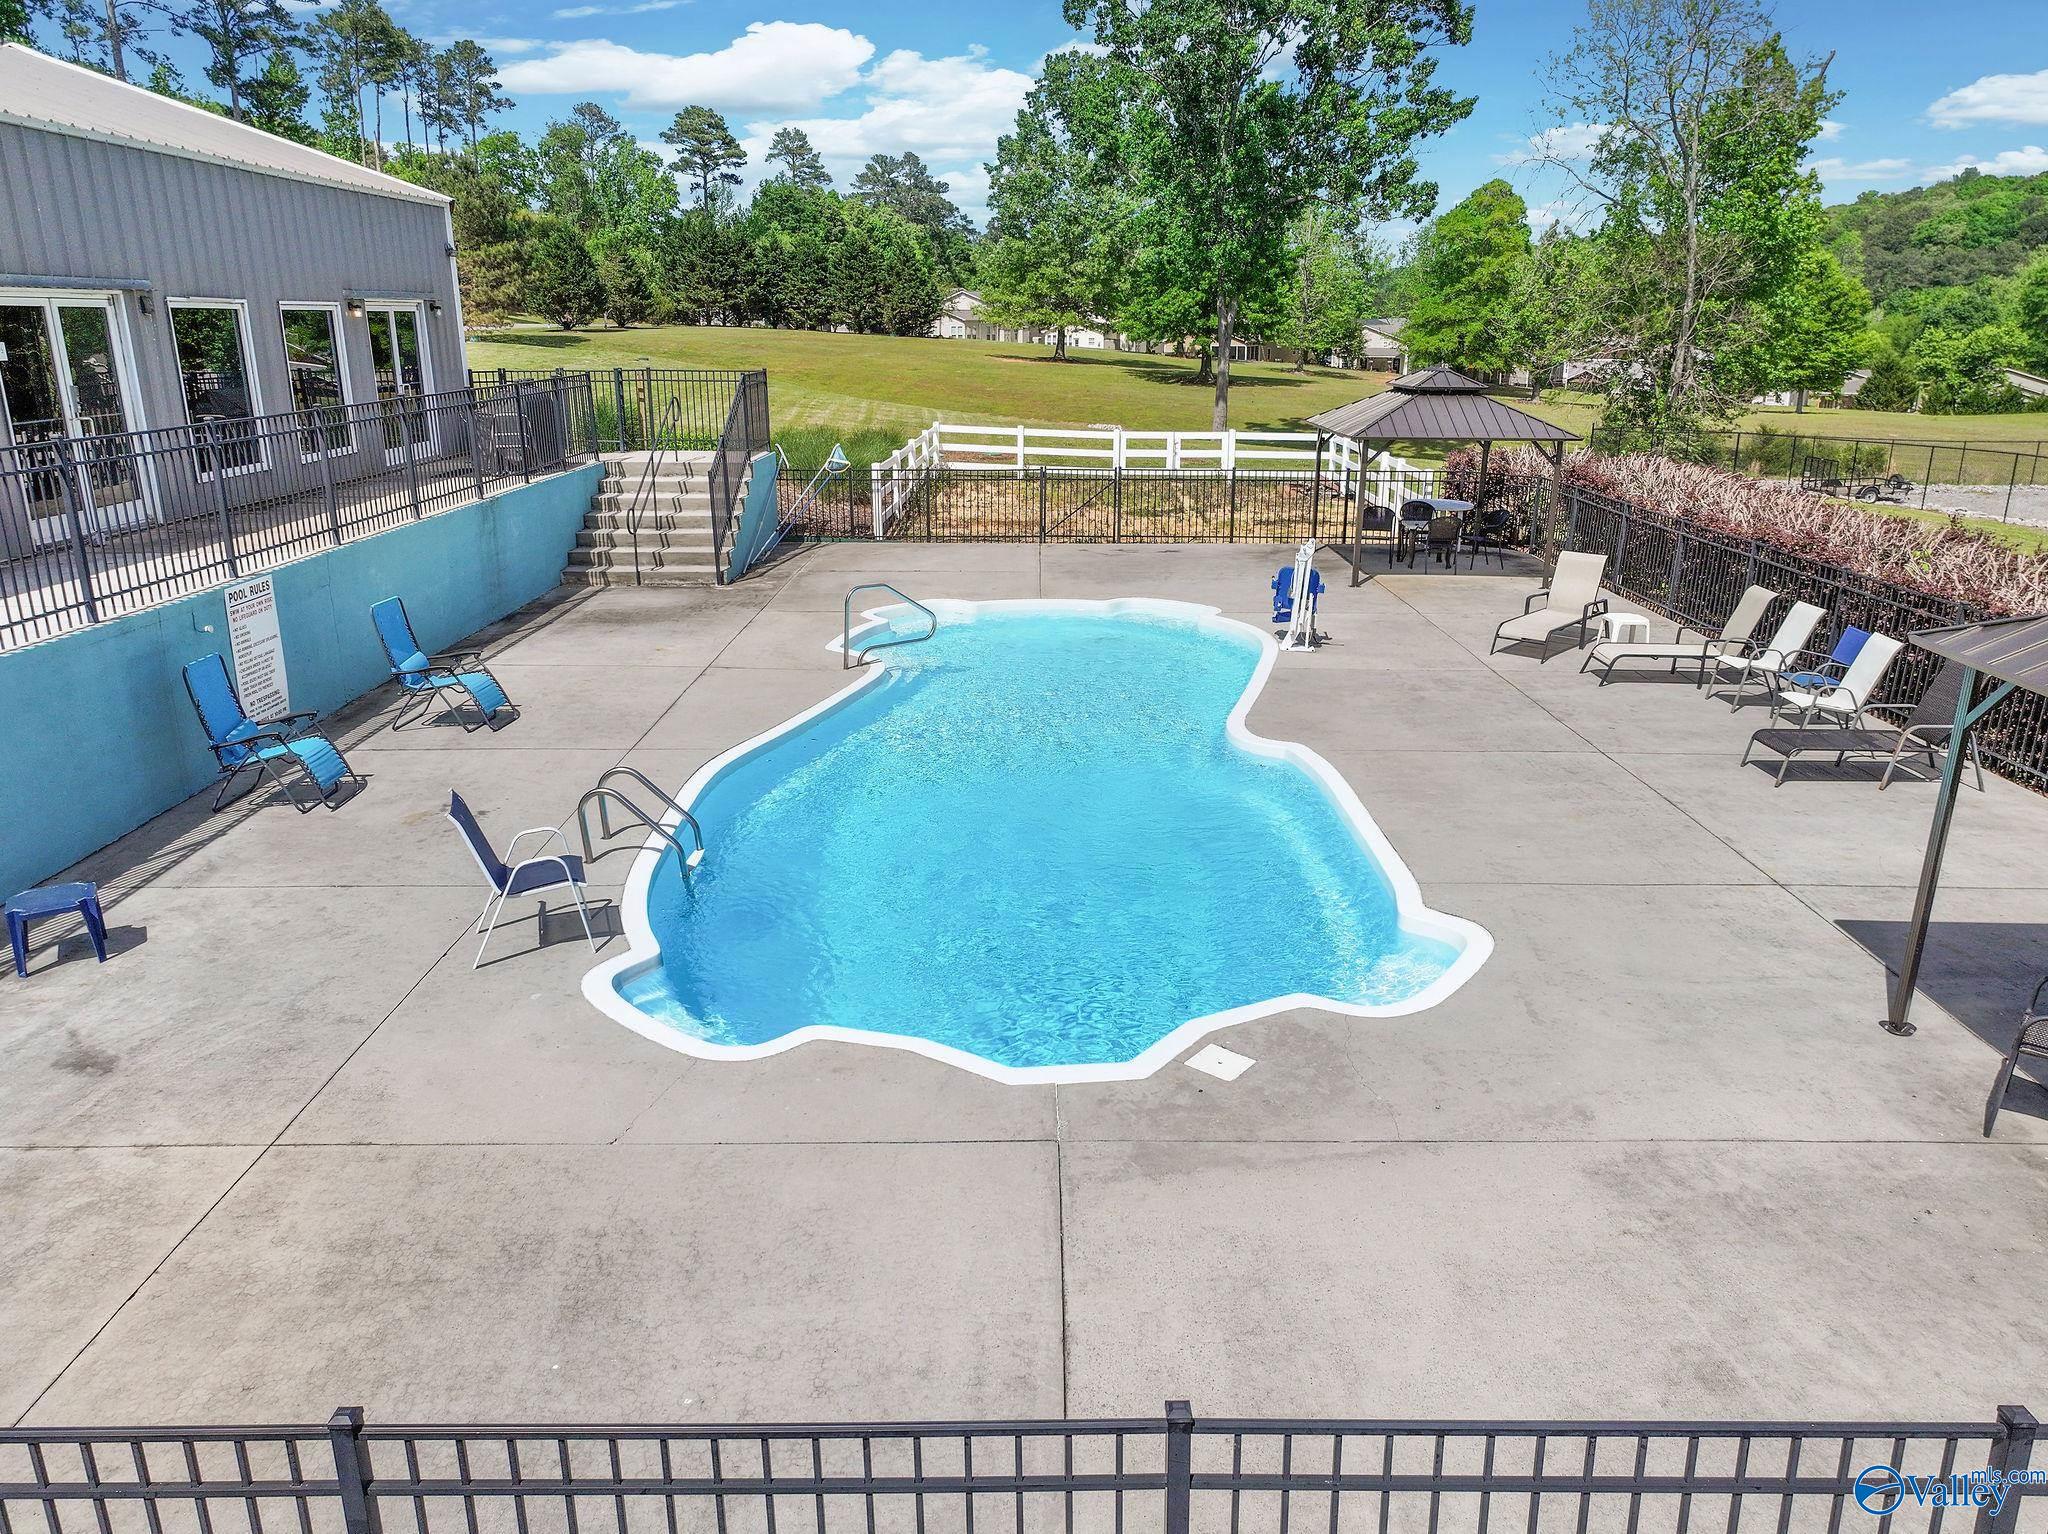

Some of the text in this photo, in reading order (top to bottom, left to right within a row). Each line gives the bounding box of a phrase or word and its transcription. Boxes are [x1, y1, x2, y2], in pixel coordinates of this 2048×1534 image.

[229, 580, 270, 603] POOL RULES
[239, 609, 257, 620] LIFEGUARD
